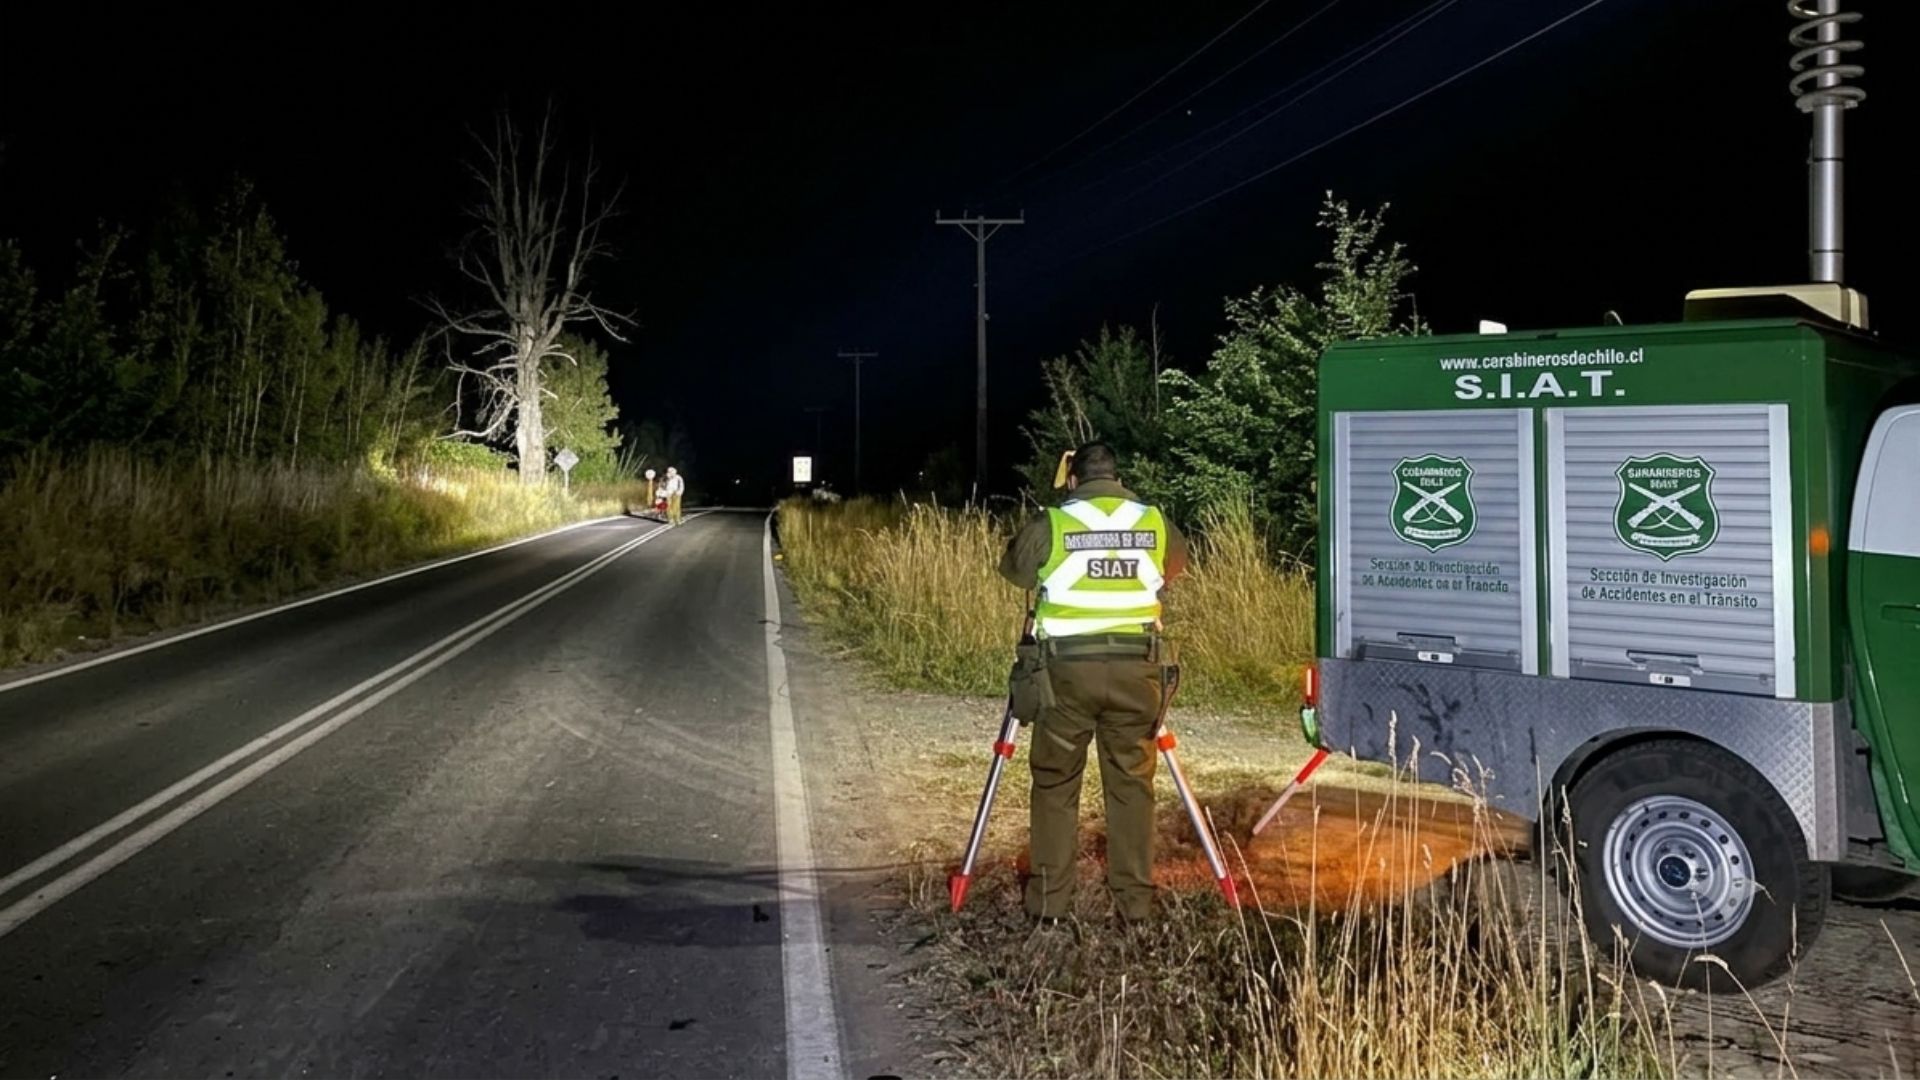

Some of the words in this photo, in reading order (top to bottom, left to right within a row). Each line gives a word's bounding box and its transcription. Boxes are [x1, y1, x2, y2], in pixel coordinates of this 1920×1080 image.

[1454, 370, 1625, 400] S.I.A.T.
[1090, 560, 1136, 578] SIAT
[1642, 570, 1657, 584] de
[1582, 586, 1596, 599] de
[1600, 586, 1666, 602] Accidentes
[1670, 592, 1685, 604] en
[1689, 592, 1701, 605] el
